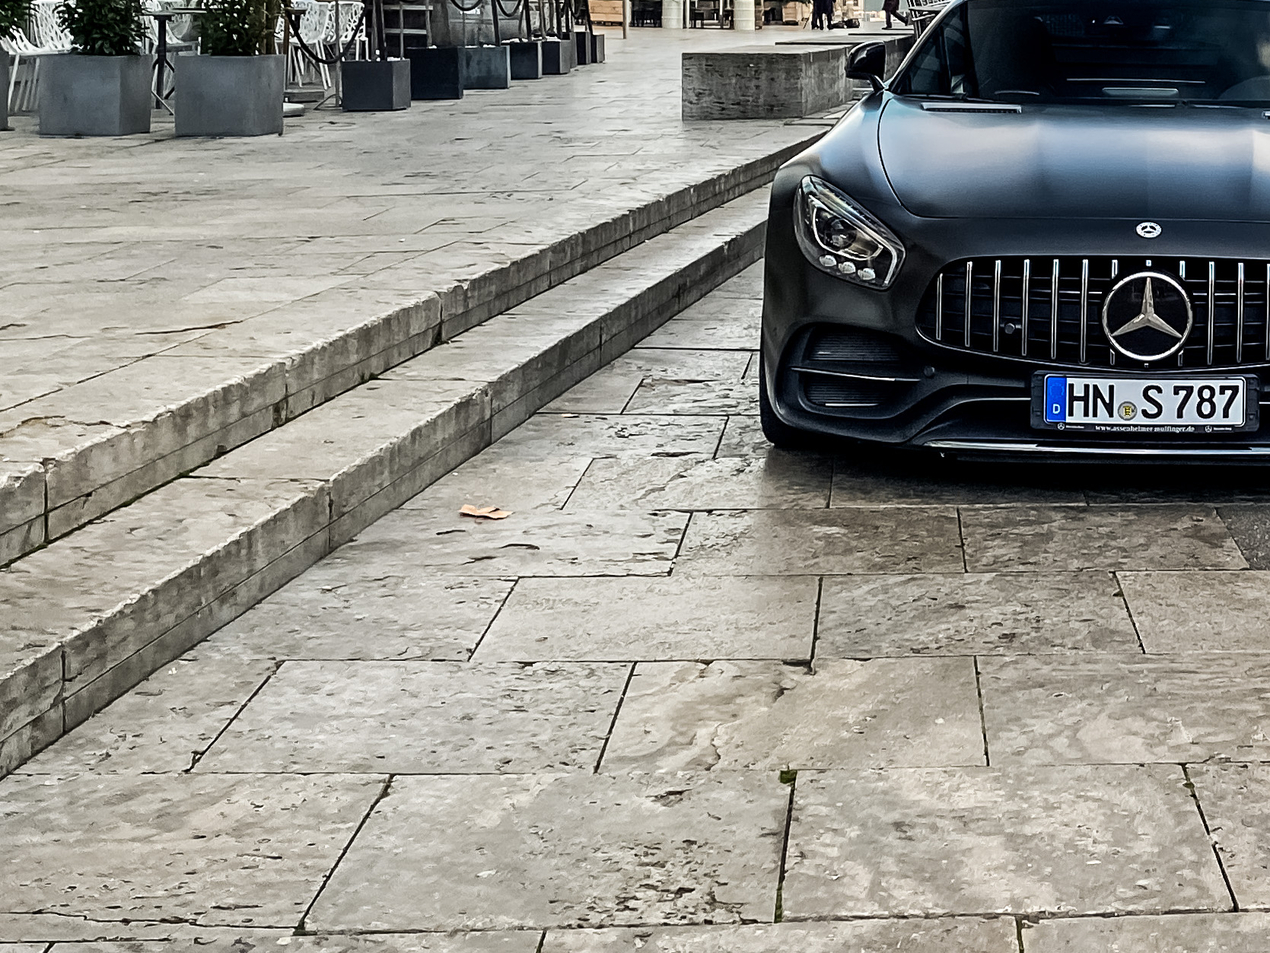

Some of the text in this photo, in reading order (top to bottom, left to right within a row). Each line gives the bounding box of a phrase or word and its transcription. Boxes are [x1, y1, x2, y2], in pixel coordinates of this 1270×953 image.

[1067, 383, 1115, 418] HN
[1141, 385, 1163, 420] S
[1173, 385, 1240, 420] 787
